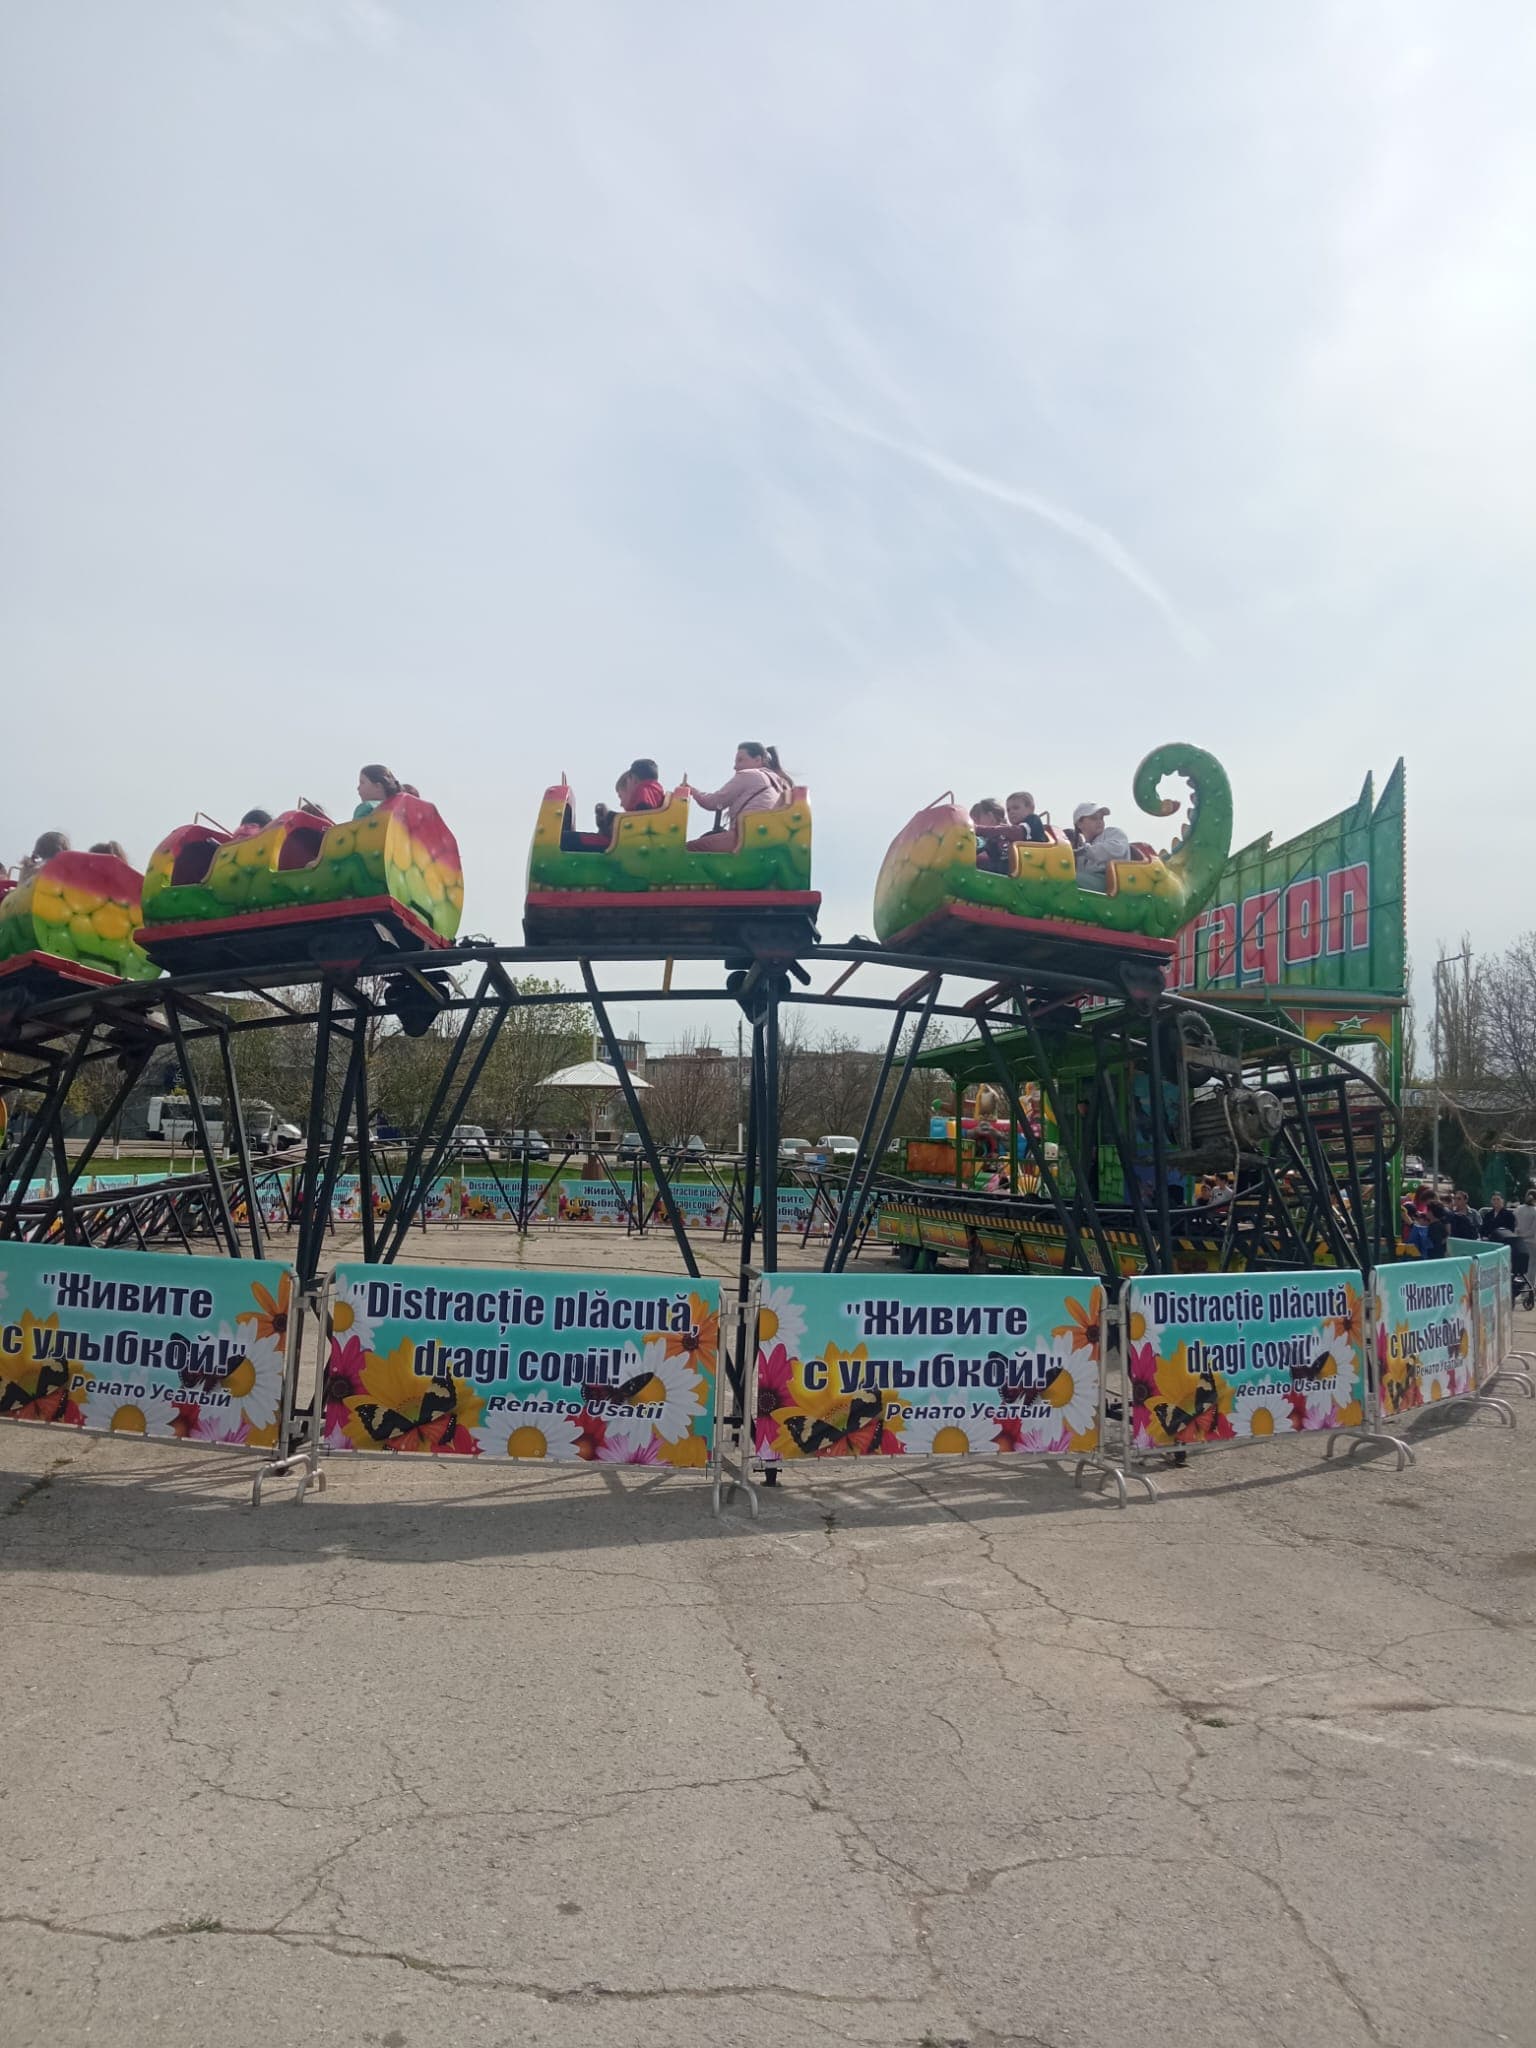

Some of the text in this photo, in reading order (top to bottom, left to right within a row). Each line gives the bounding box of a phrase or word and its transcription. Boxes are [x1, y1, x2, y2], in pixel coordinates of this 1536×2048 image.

[43, 1271, 213, 1319] "Живите
[353, 1281, 699, 1336] "Distracție plăcută,
[1143, 1285, 1352, 1330] "Distracție plăcută,
[1400, 1283, 1454, 1312] "Живите
[847, 1300, 1028, 1336] "Живите
[2, 1324, 246, 1375] с улыбкой!"
[414, 1340, 637, 1386] dragi copii!"
[1187, 1338, 1246, 1375] dragi
[71, 1375, 231, 1408] Ренато Усатый
[804, 1352, 1062, 1394] с улыбкой!"
[1236, 1381, 1291, 1398] Renato
[488, 1396, 581, 1415] Renato
[886, 1402, 1052, 1421] Ренато Усатый
